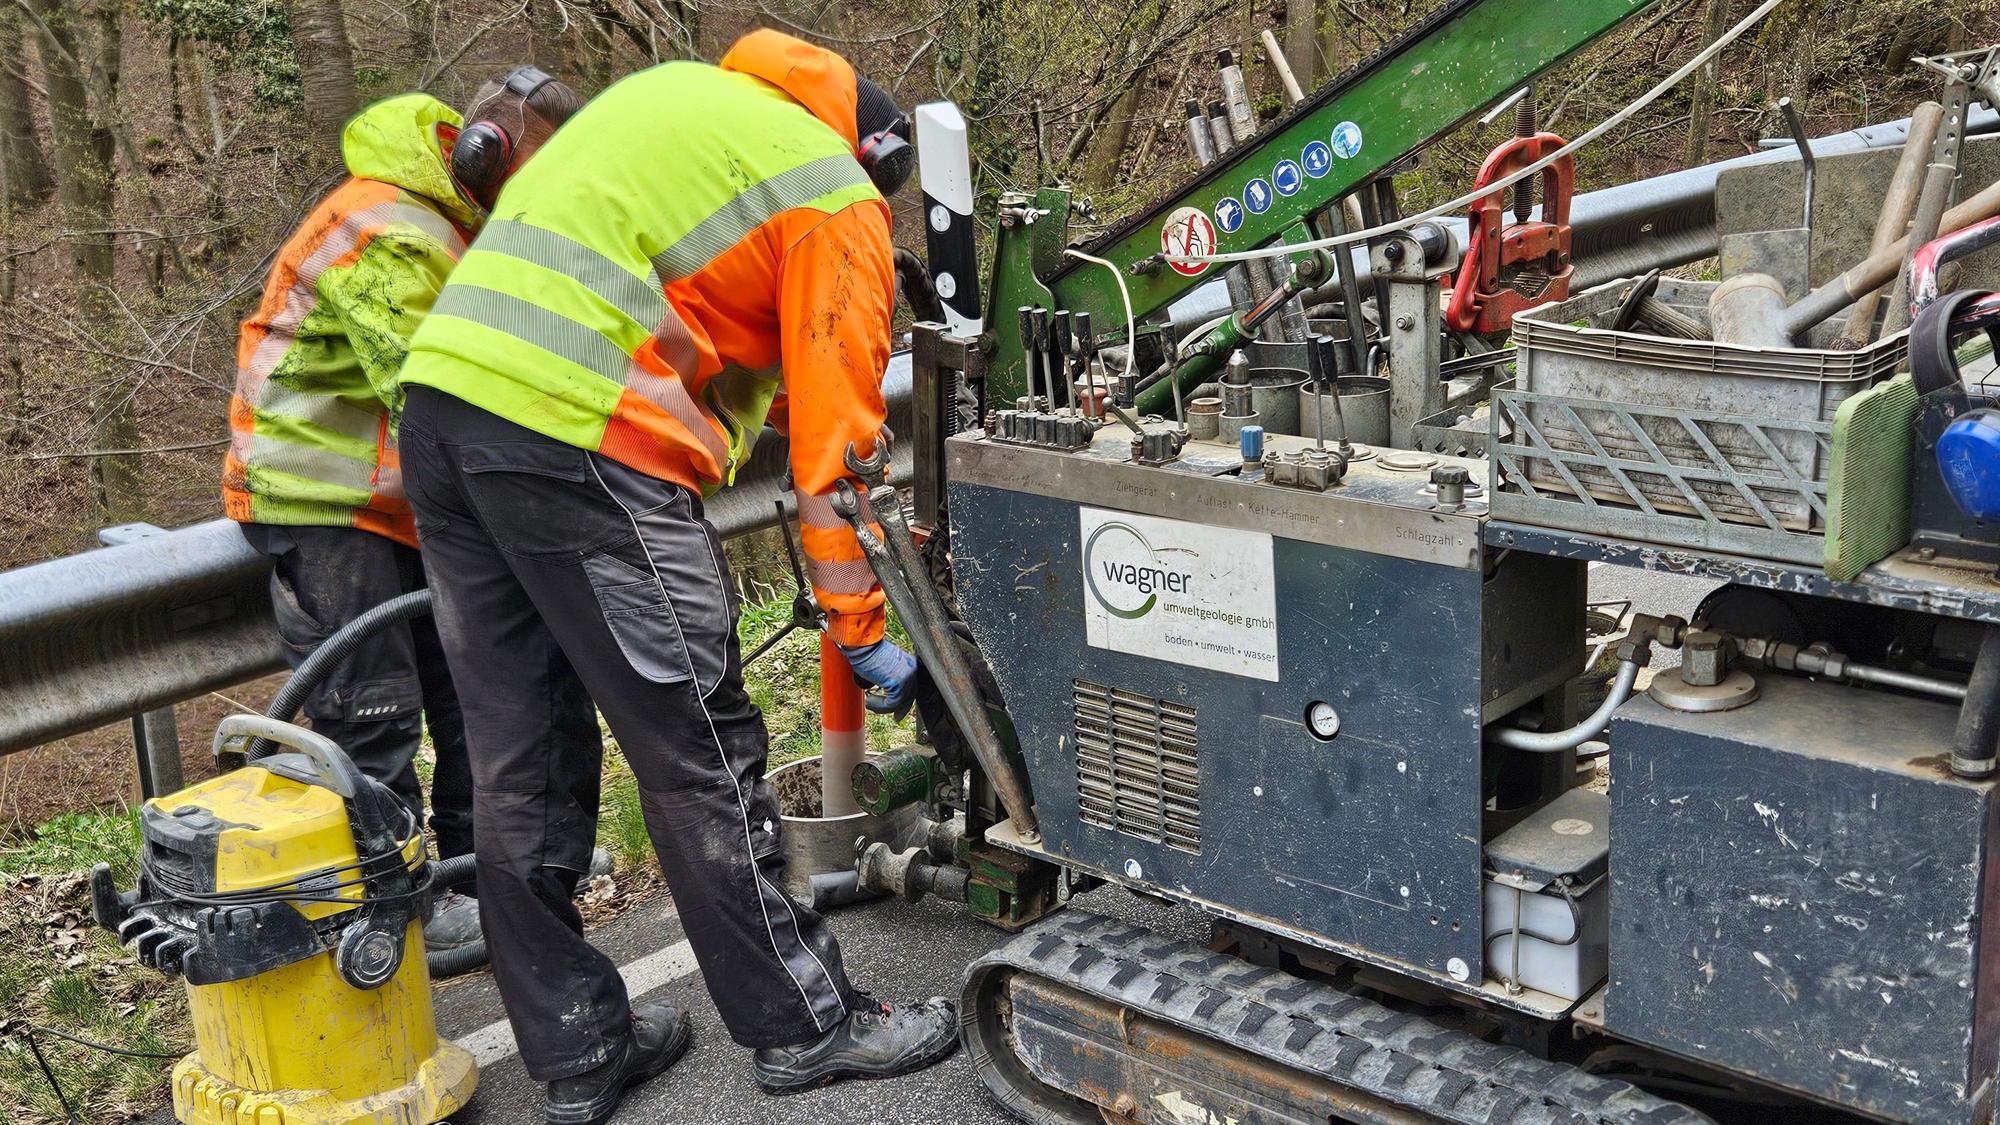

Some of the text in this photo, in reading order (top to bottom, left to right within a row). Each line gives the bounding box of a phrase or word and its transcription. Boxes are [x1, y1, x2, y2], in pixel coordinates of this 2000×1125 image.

[1197, 494, 1233, 510] Auflast
[1248, 502, 1321, 524] Kette-Hammer
[1395, 526, 1455, 547] Schlagzahl
[1103, 560, 1192, 594] wagner
[1163, 602, 1275, 631] umweltgeologie gmbh
[1164, 633, 1276, 663] boden umwelt wasser
